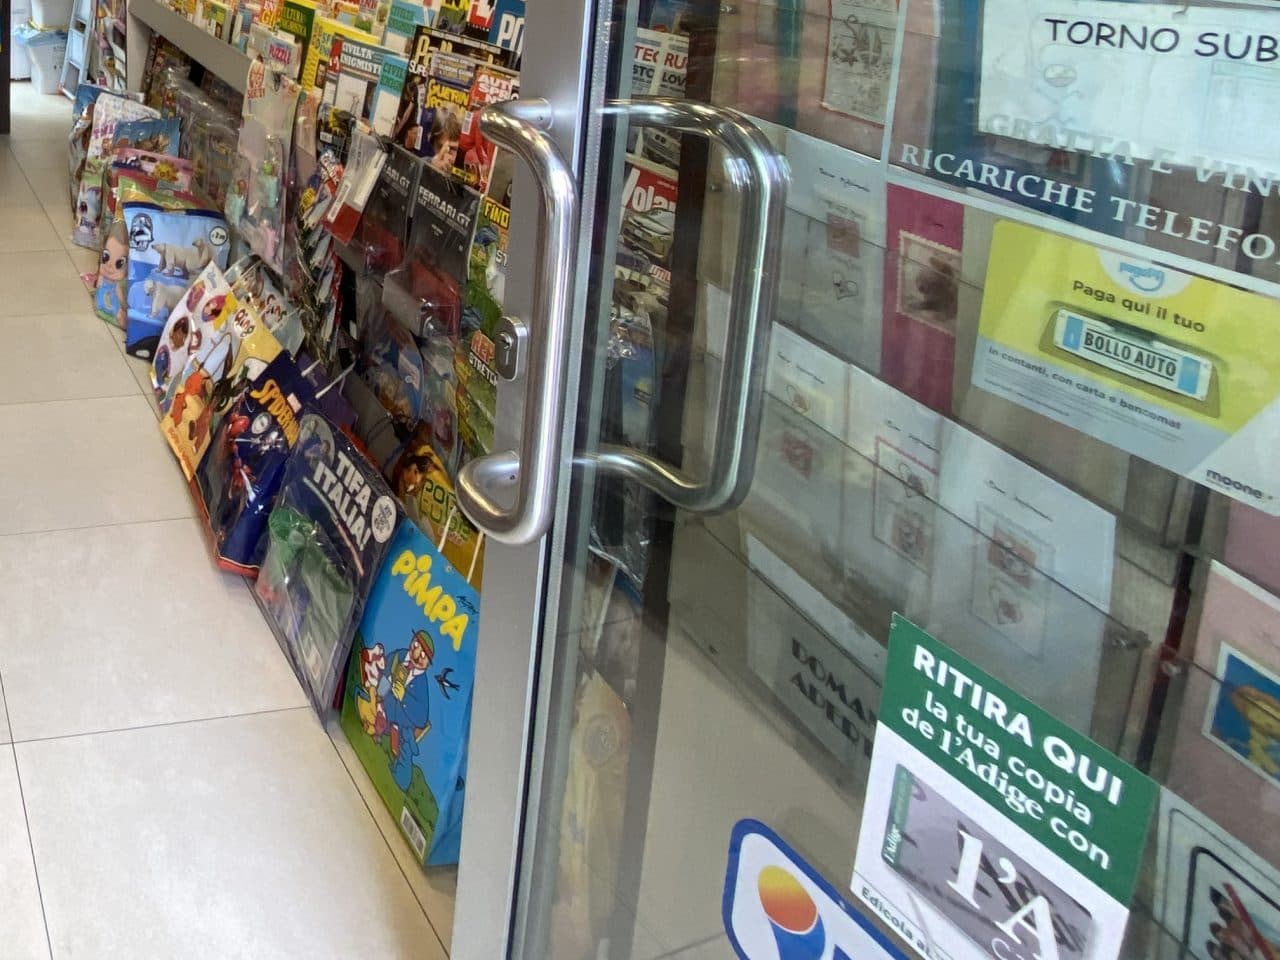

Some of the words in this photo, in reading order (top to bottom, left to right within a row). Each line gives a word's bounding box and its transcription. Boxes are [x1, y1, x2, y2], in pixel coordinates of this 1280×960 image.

[269, 42, 292, 65] PUZZLE
[1044, 18, 1181, 53] TORNO
[1193, 32, 1279, 63] SUB
[419, 186, 458, 219] FERRARI
[457, 211, 471, 228] GT
[899, 143, 1096, 214] RICARICHE
[1110, 195, 1276, 260] TELEFO
[1072, 280, 1116, 304] Paga
[1122, 295, 1151, 318] qui
[1156, 306, 1168, 321] il
[1173, 312, 1206, 334] tuo
[1001, 350, 1049, 379] contanti,
[1052, 370, 1073, 386] con
[1076, 379, 1106, 401] carta
[1120, 399, 1182, 431] bancomat
[1083, 331, 1131, 361] BOLLO
[1133, 349, 1177, 378] AUTO
[313, 460, 371, 552] ITALIA!
[335, 450, 371, 515] TIFA
[390, 548, 470, 653] PIMPA
[912, 643, 1034, 748] RITIRA
[1041, 733, 1123, 807] QUI
[925, 691, 948, 724] la
[956, 715, 1001, 761] tua
[1007, 754, 1093, 826] copia
[901, 705, 935, 740] de
[937, 729, 1044, 821] l'Adige
[1050, 817, 1112, 871] con
[861, 887, 914, 940] Edicola
